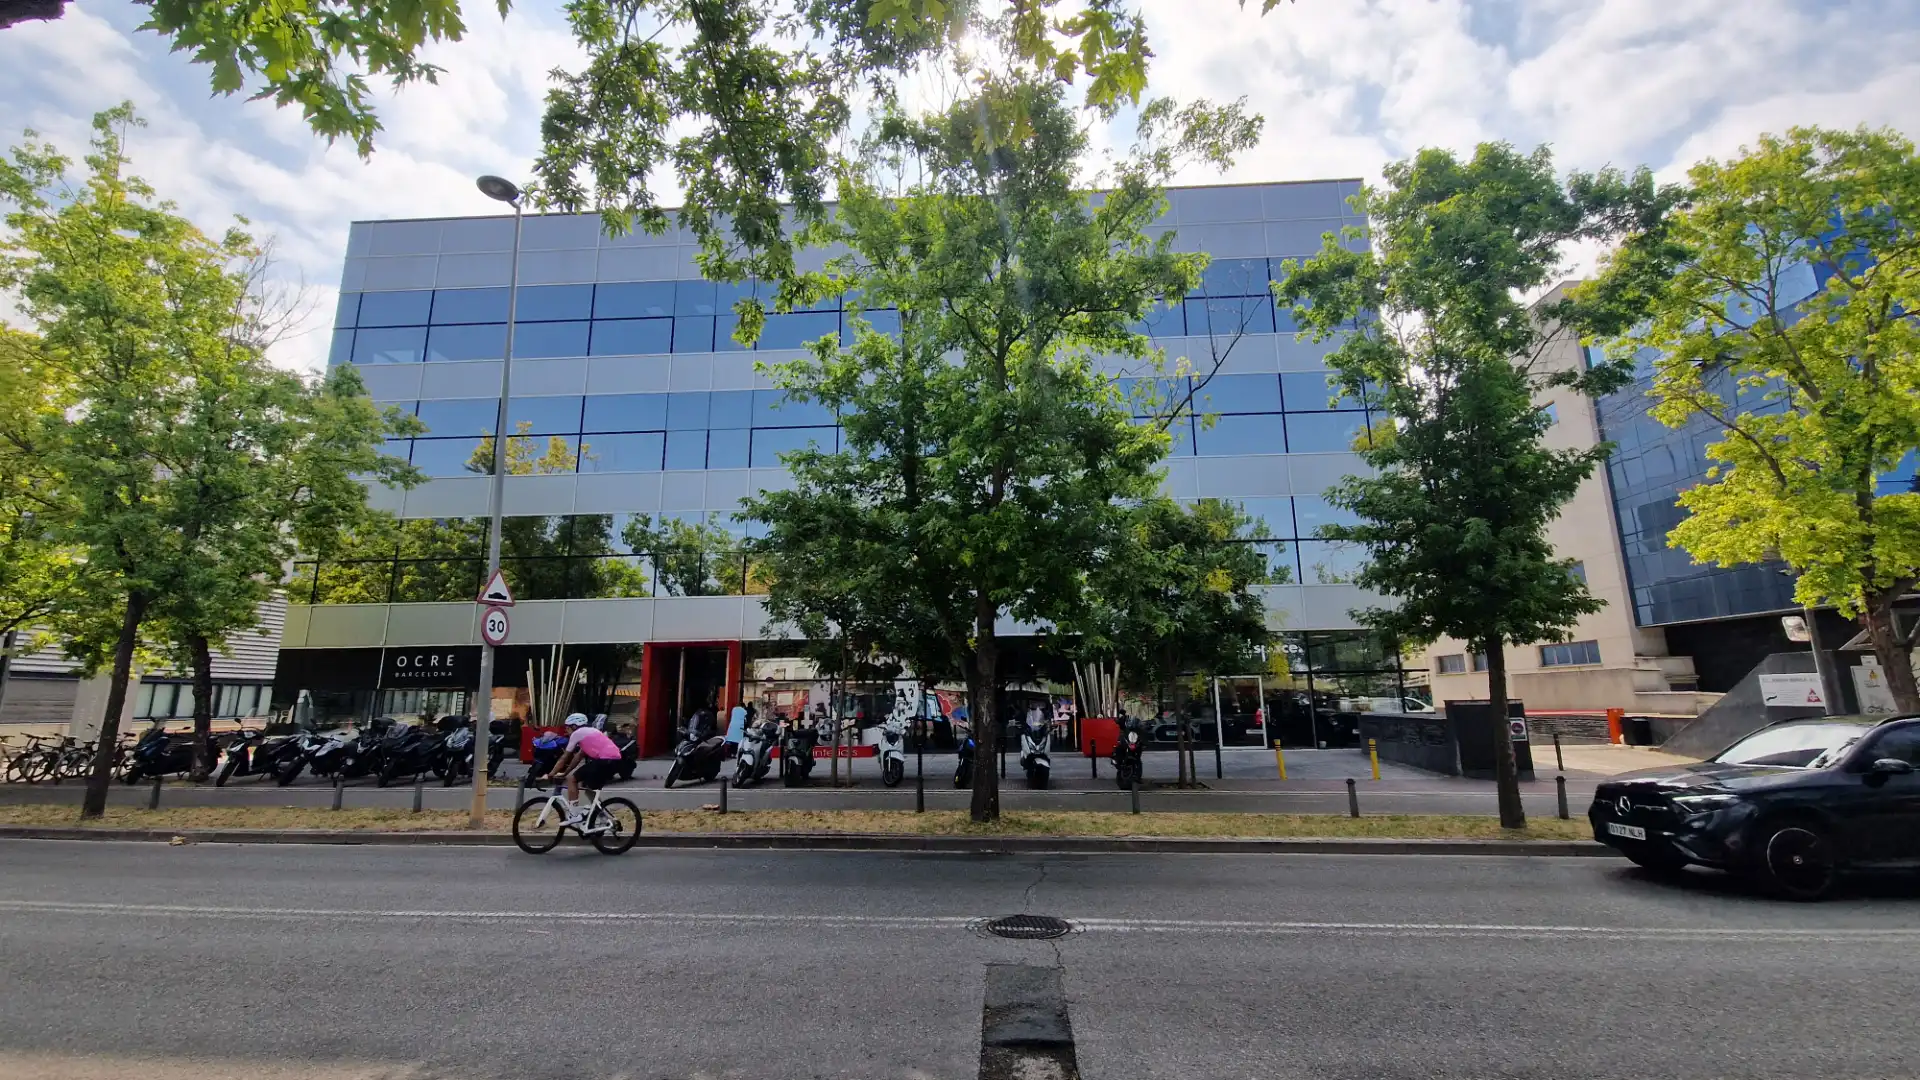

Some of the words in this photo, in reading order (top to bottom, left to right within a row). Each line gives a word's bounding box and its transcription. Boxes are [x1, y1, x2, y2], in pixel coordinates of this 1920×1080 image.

[489, 619, 505, 633] 30
[396, 654, 455, 668] OCRE
[812, 747, 858, 757] inteios
